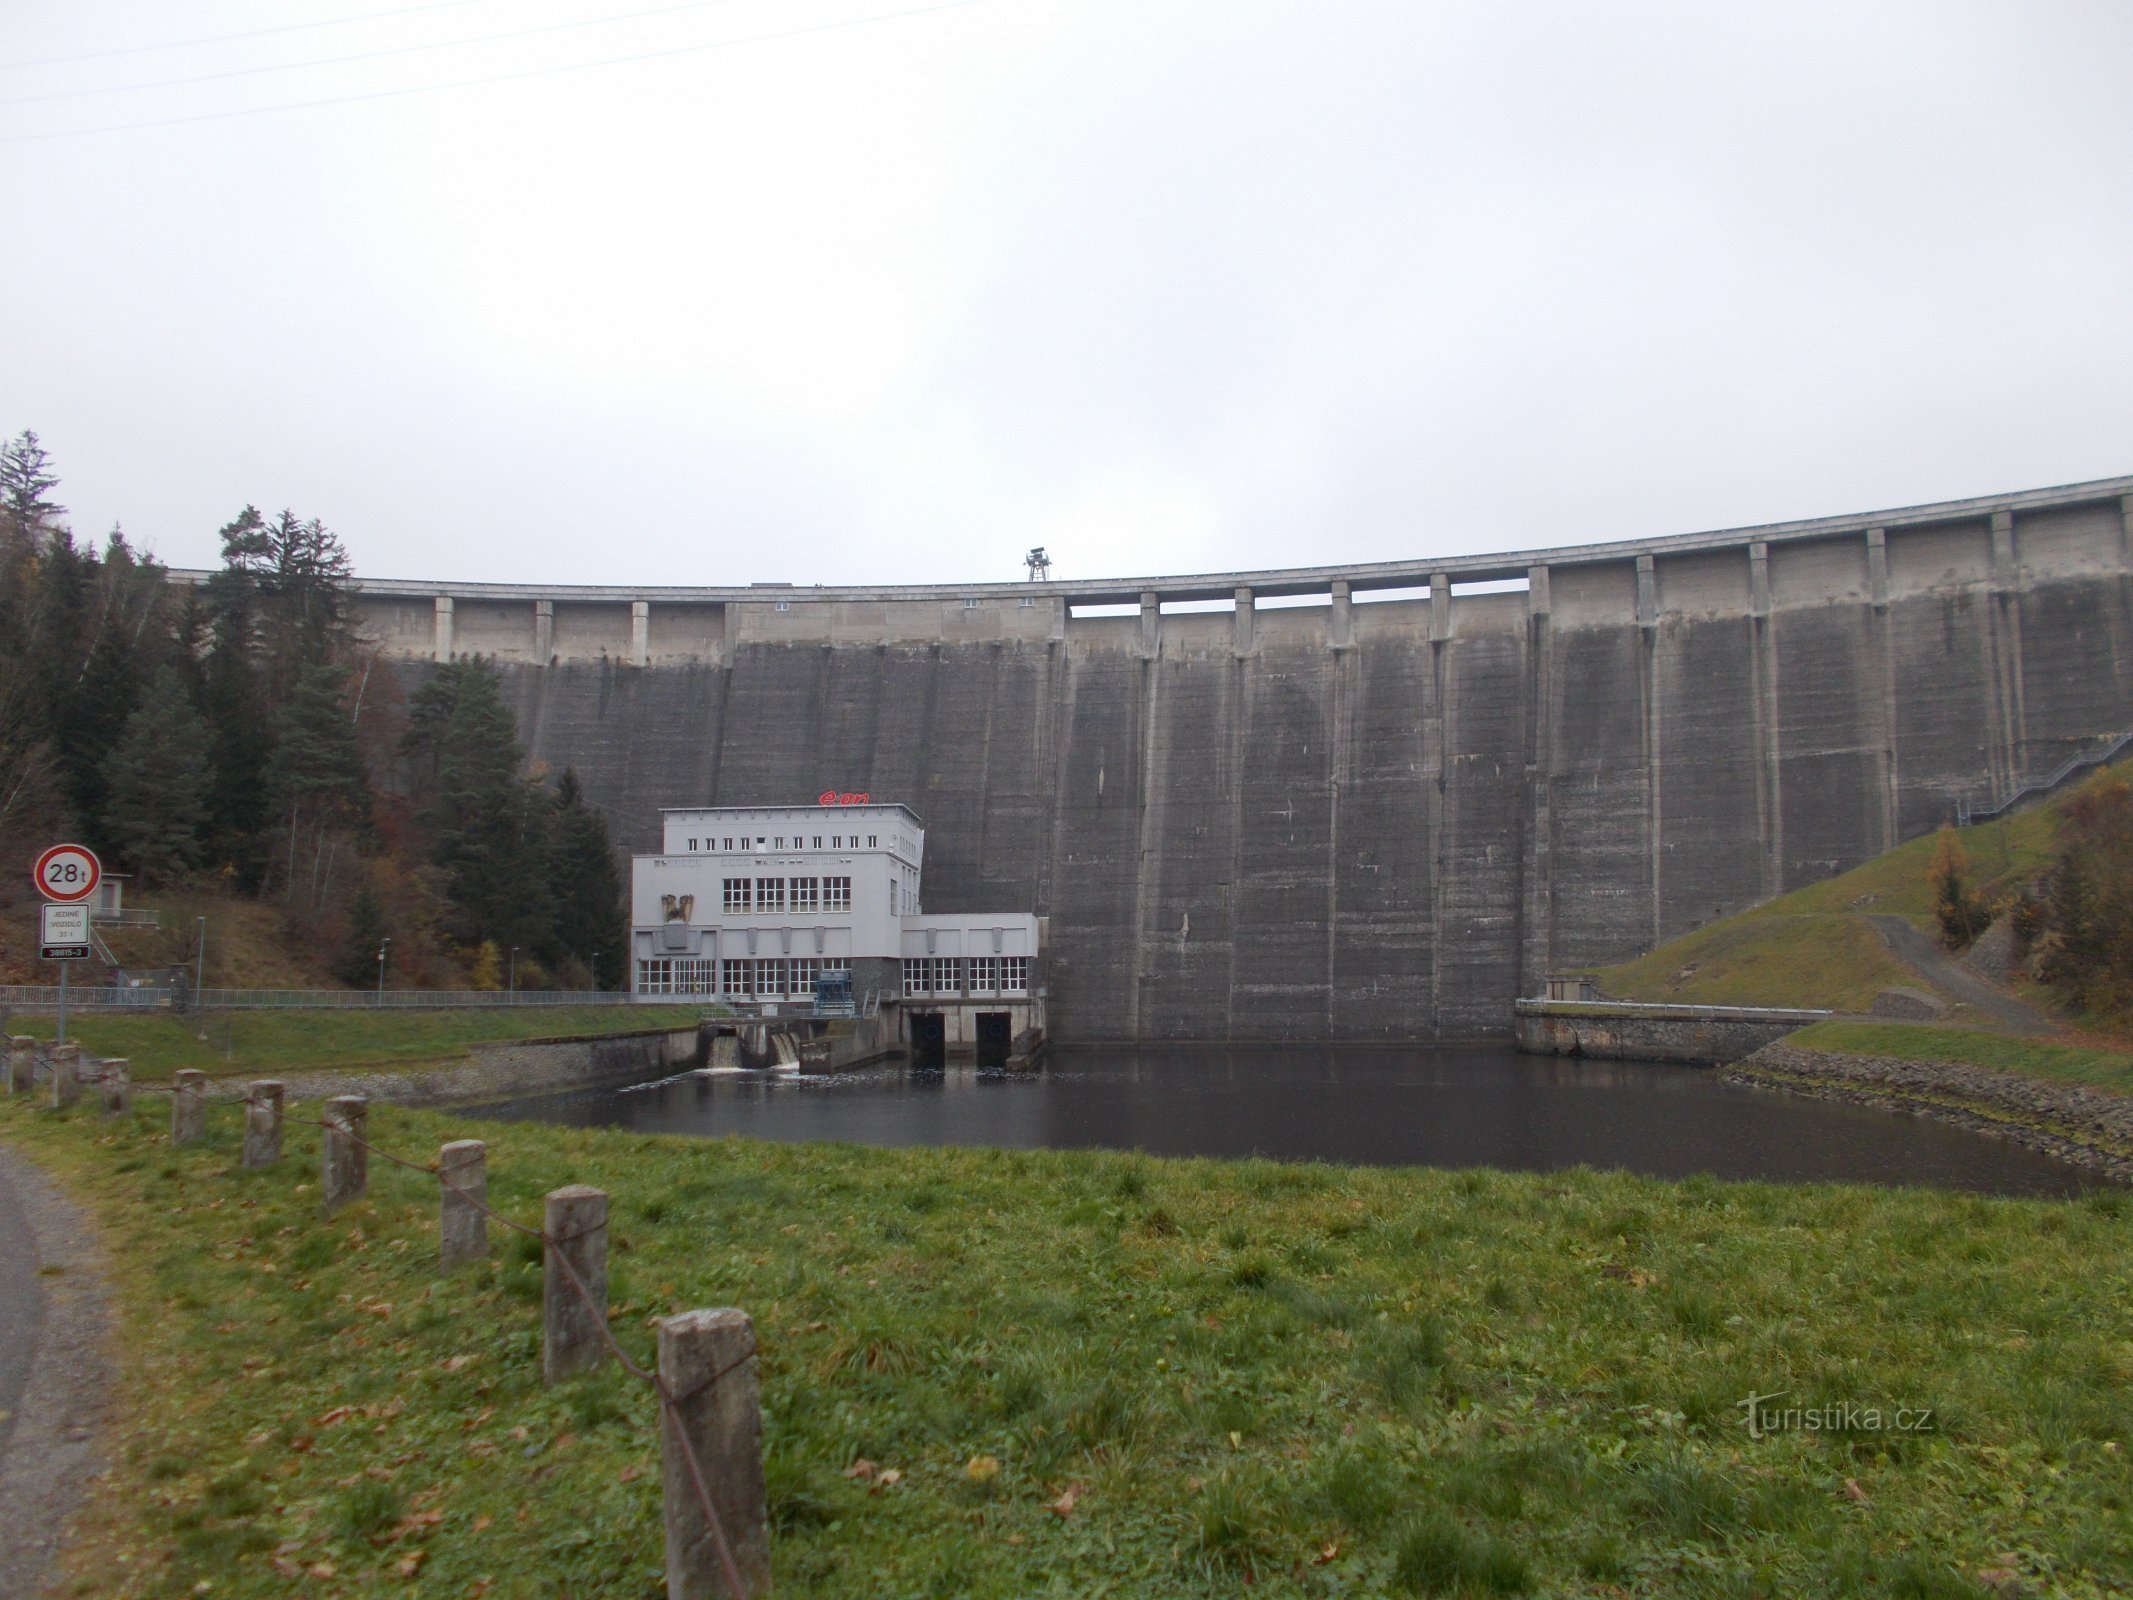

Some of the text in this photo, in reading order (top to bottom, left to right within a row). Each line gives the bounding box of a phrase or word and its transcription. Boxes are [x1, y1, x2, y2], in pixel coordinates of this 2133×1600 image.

[49, 863, 87, 883] 28 t
[51, 920, 82, 928] VOZIDLO
